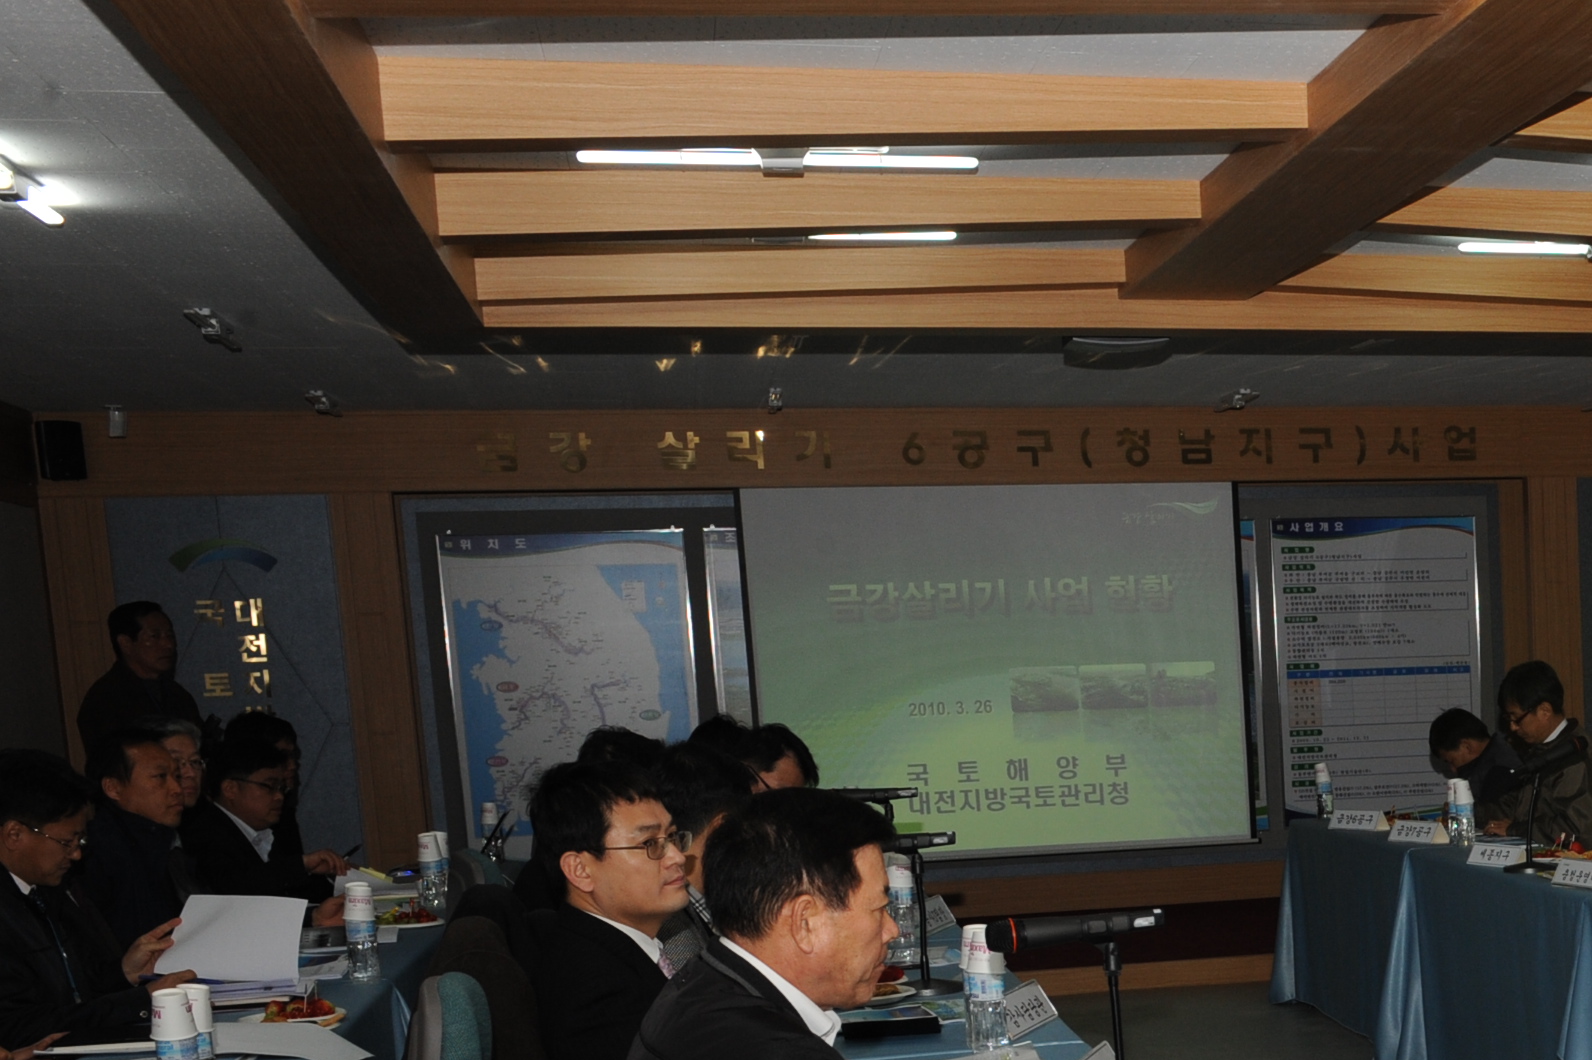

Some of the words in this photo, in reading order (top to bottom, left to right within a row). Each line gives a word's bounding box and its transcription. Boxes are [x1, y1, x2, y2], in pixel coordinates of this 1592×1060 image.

[657, 429, 832, 471] 살리기
[1289, 521, 1344, 533] 사업개요
[458, 537, 527, 551] 위치도
[826, 577, 1008, 623] 금강살리기
[1027, 575, 1094, 616] 사업
[908, 700, 951, 718] 2010.
[956, 700, 971, 716] 3.
[974, 699, 993, 714] 26
[908, 782, 1130, 816] 대전지방국토관리청
